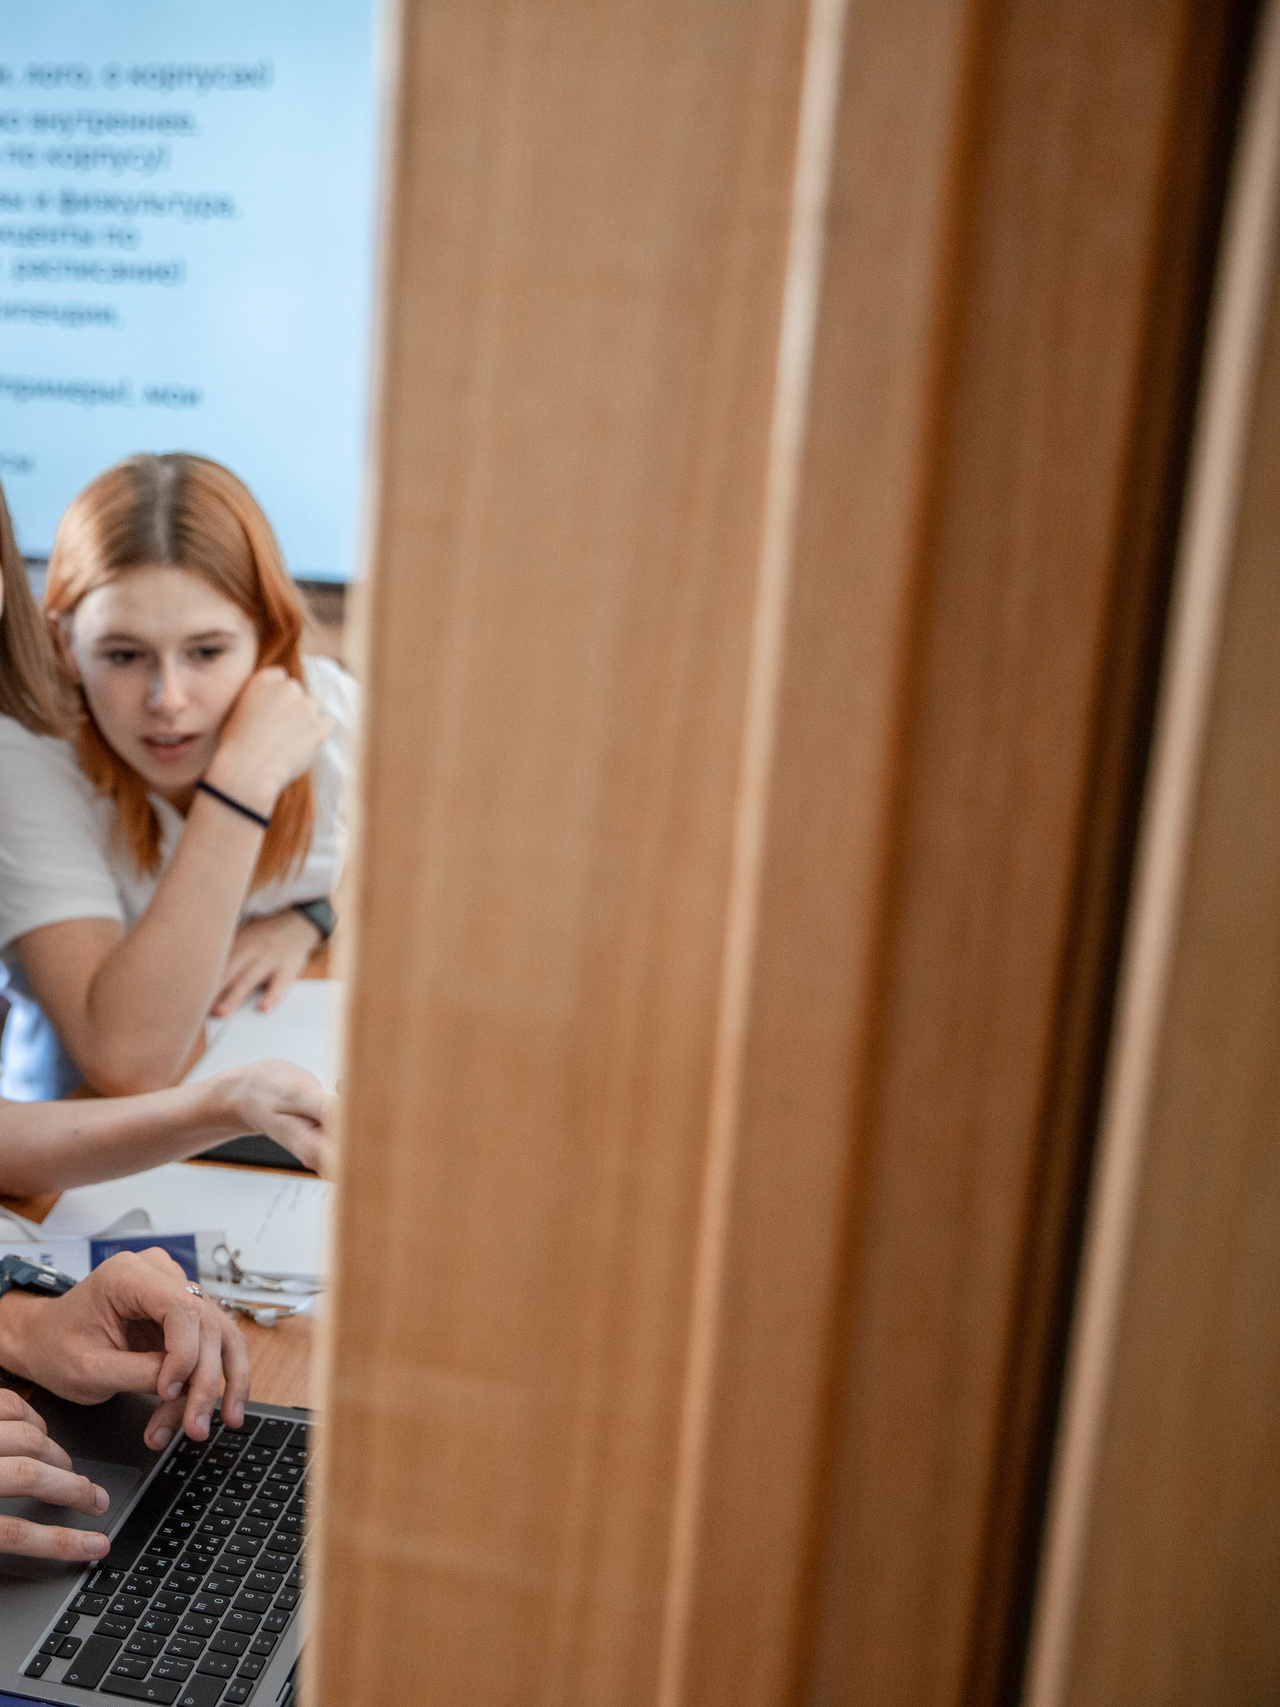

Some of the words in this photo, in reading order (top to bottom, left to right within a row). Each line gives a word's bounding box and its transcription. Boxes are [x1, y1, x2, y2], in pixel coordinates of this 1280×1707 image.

[104, 65, 123, 86] о
[129, 59, 272, 94] корпусах)
[5, 147, 39, 165] по
[46, 142, 170, 174] корпусу)
[33, 192, 51, 210] и
[103, 227, 138, 247] по
[87, 1570, 103, 1589] command
[74, 1594, 86, 1608] option
